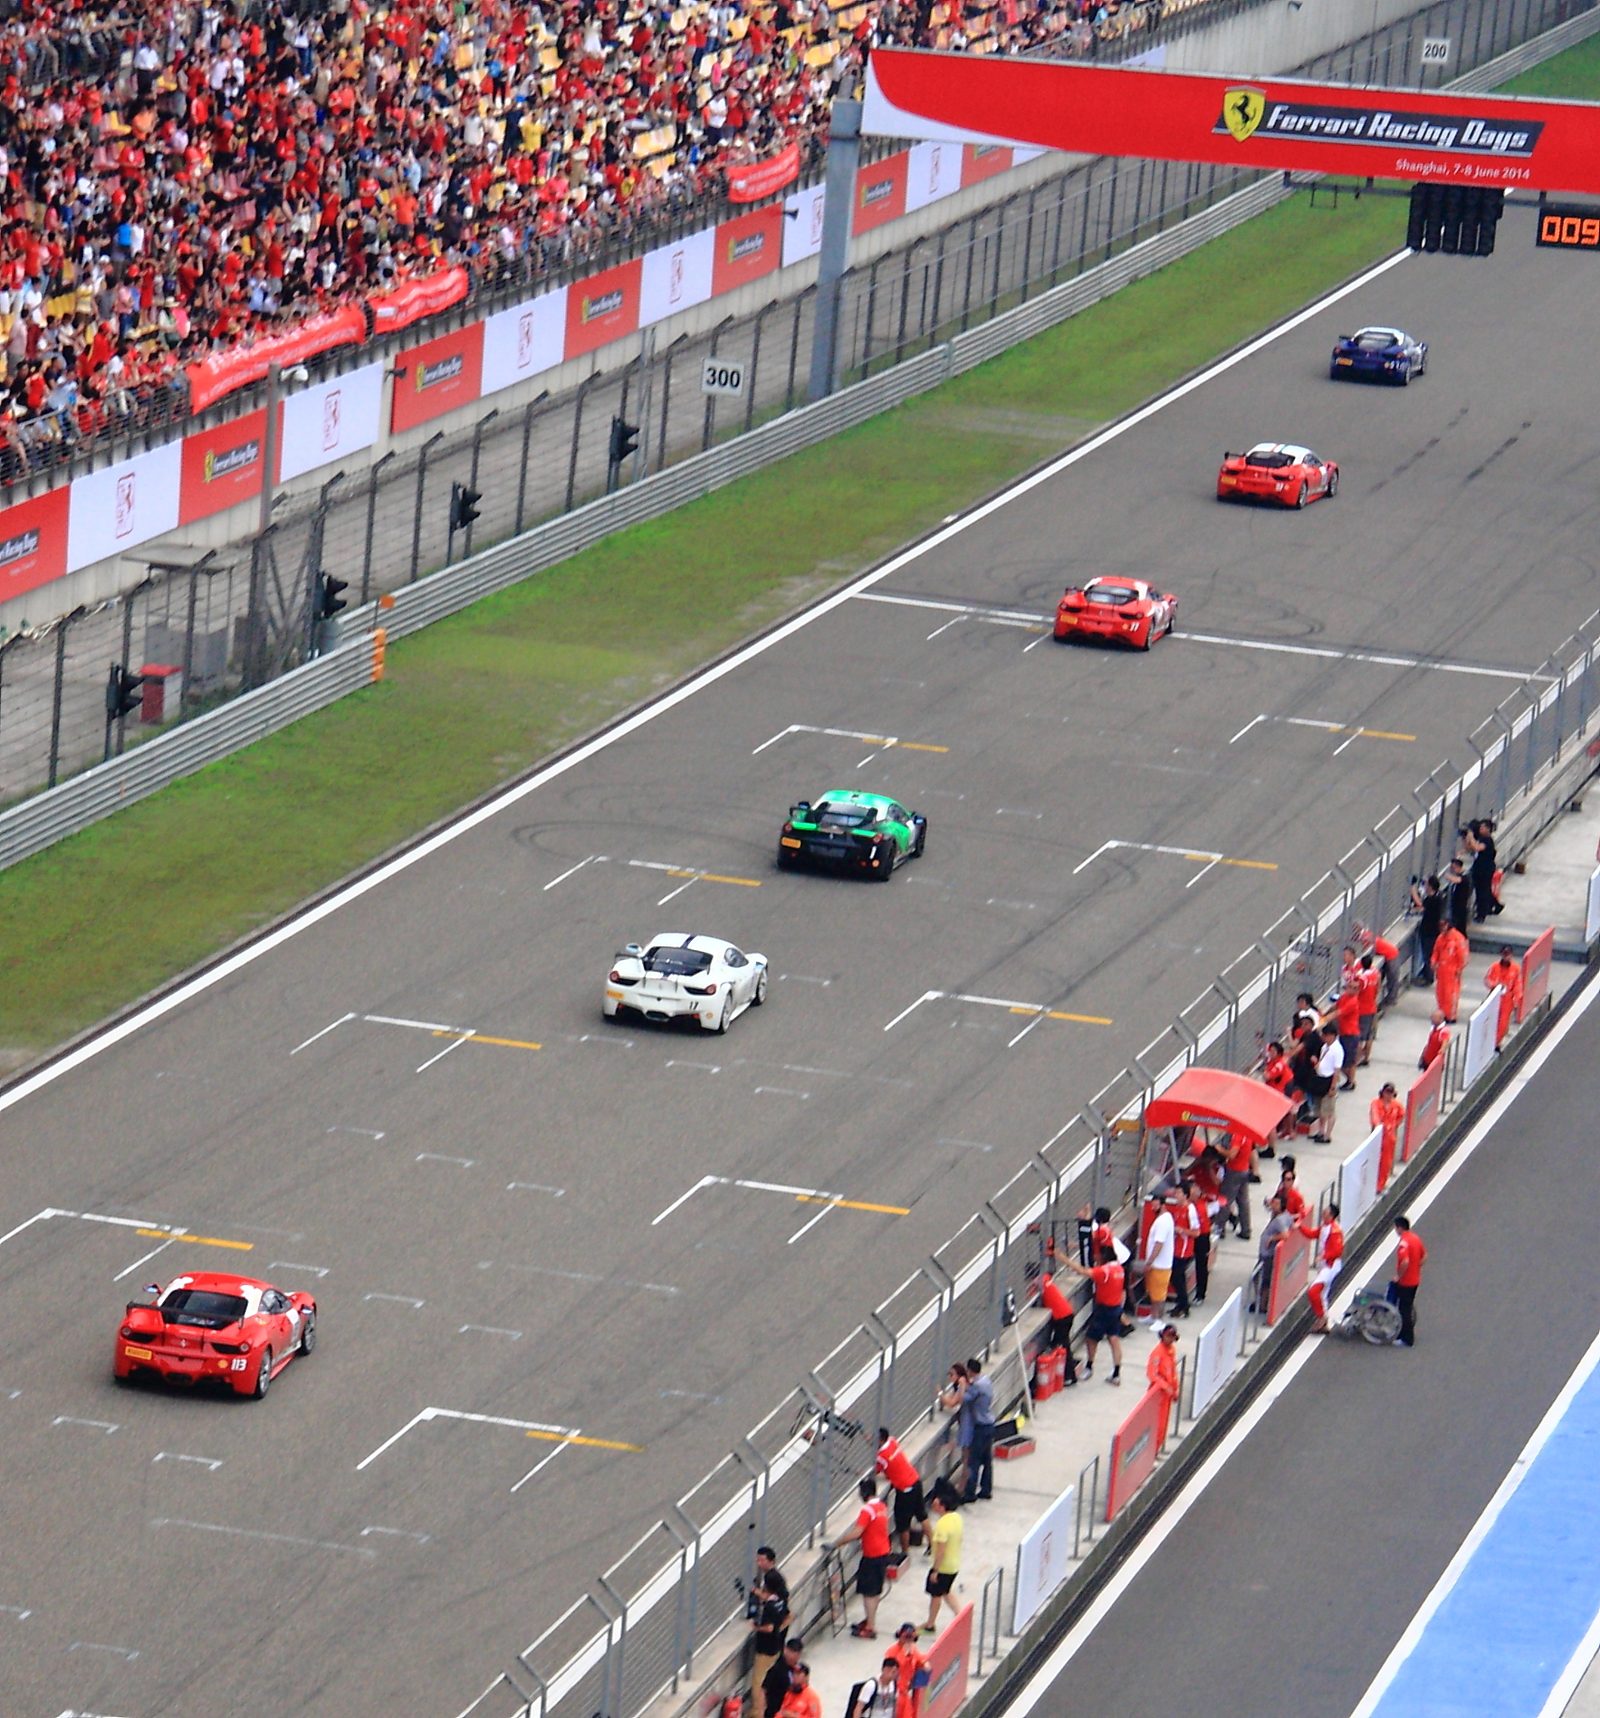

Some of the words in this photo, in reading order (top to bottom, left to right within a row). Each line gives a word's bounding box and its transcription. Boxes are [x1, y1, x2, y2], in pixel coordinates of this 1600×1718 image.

[1424, 43, 1447, 58] 200
[1267, 104, 1367, 136] Ferrari
[1367, 112, 1458, 147] Racing
[1460, 119, 1529, 151] Days
[1395, 158, 1450, 175] Shanghai,
[1453, 163, 1473, 176] 7-8
[1473, 165, 1500, 179] June
[1502, 167, 1531, 180] 2014
[1541, 215, 1600, 245] 009
[706, 367, 740, 388] 300
[231, 1358, 247, 1371] 113
